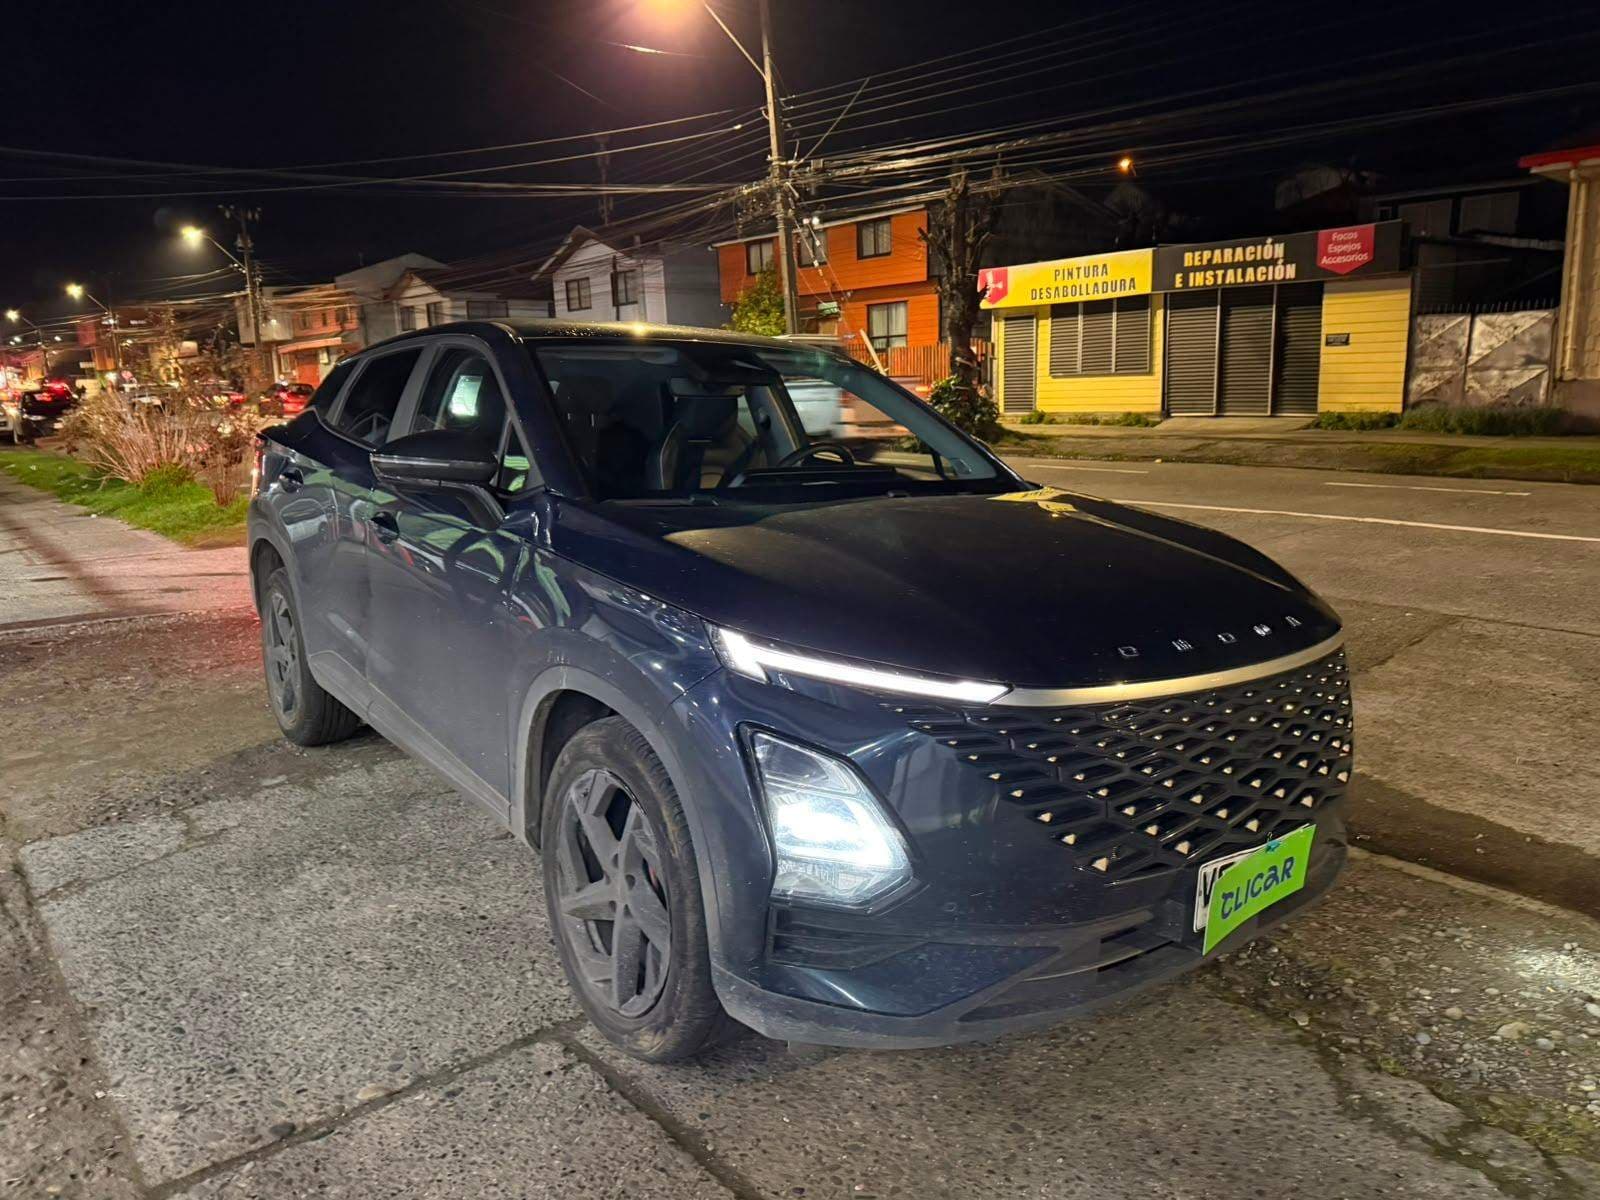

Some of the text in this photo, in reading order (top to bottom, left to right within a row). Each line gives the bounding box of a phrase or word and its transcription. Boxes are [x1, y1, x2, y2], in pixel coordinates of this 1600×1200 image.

[1332, 232, 1358, 241] Focos
[1184, 237, 1285, 267] REPARACIÓN
[1328, 243, 1361, 254] Espejos
[1321, 252, 1368, 264] Accesorios
[1054, 263, 1108, 281] PINTURA
[1175, 259, 1296, 288] E INSTALACIÓN
[1031, 278, 1136, 300] DESABOLLADURA
